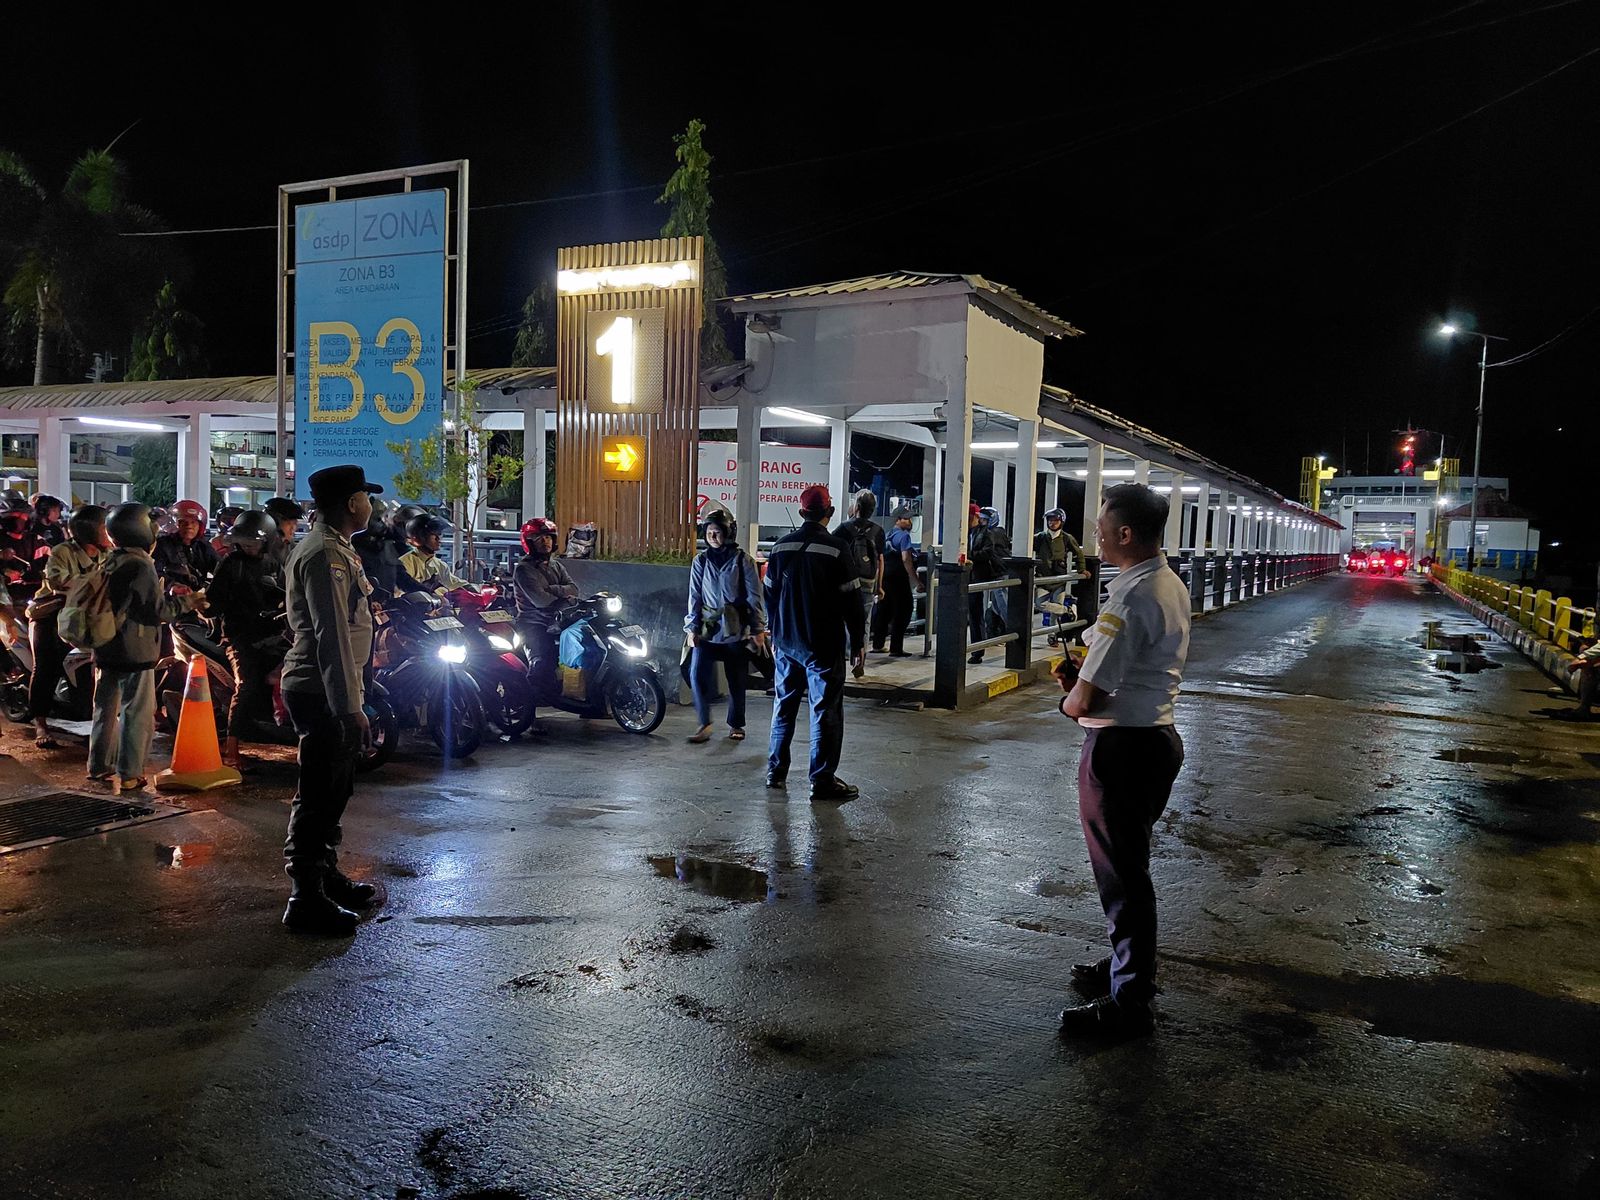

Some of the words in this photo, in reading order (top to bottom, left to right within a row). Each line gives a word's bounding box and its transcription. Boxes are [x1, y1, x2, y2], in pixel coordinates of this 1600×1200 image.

[362, 208, 438, 242] ZONA
[313, 230, 350, 251] asdp
[339, 266, 375, 282] ZONA
[379, 264, 395, 278] B3
[335, 286, 354, 295] AREA
[355, 282, 400, 293] KENDARAAN
[300, 338, 318, 347] AREA
[323, 337, 346, 346] AKSES
[400, 334, 425, 343] KAPAL
[300, 349, 318, 358] AREA
[359, 347, 378, 356] ATAU
[383, 346, 436, 356] PEMERIKSAAN
[327, 359, 366, 368] ANGKUTAN
[595, 316, 634, 404] 1
[309, 317, 426, 425] B3
[316, 371, 359, 380] KENDARAAN
[313, 393, 331, 402] POS
[335, 393, 405, 402] PEMERIKSAAN
[409, 392, 436, 401] ATAU
[313, 404, 353, 413] MANLESS
[357, 404, 408, 413] VALIDATOR
[411, 403, 438, 412] TIKET
[313, 427, 351, 436] MOVEABLE
[351, 427, 380, 436] BRIDGE
[313, 438, 347, 447] DERMAGA
[348, 438, 373, 447] BETON
[313, 449, 347, 458] DERMAGA
[348, 449, 379, 458] PONTON
[726, 459, 802, 475] DRANG
[758, 480, 778, 489] DAN
[720, 492, 731, 501] DI
[760, 494, 801, 503] PERAIRA
